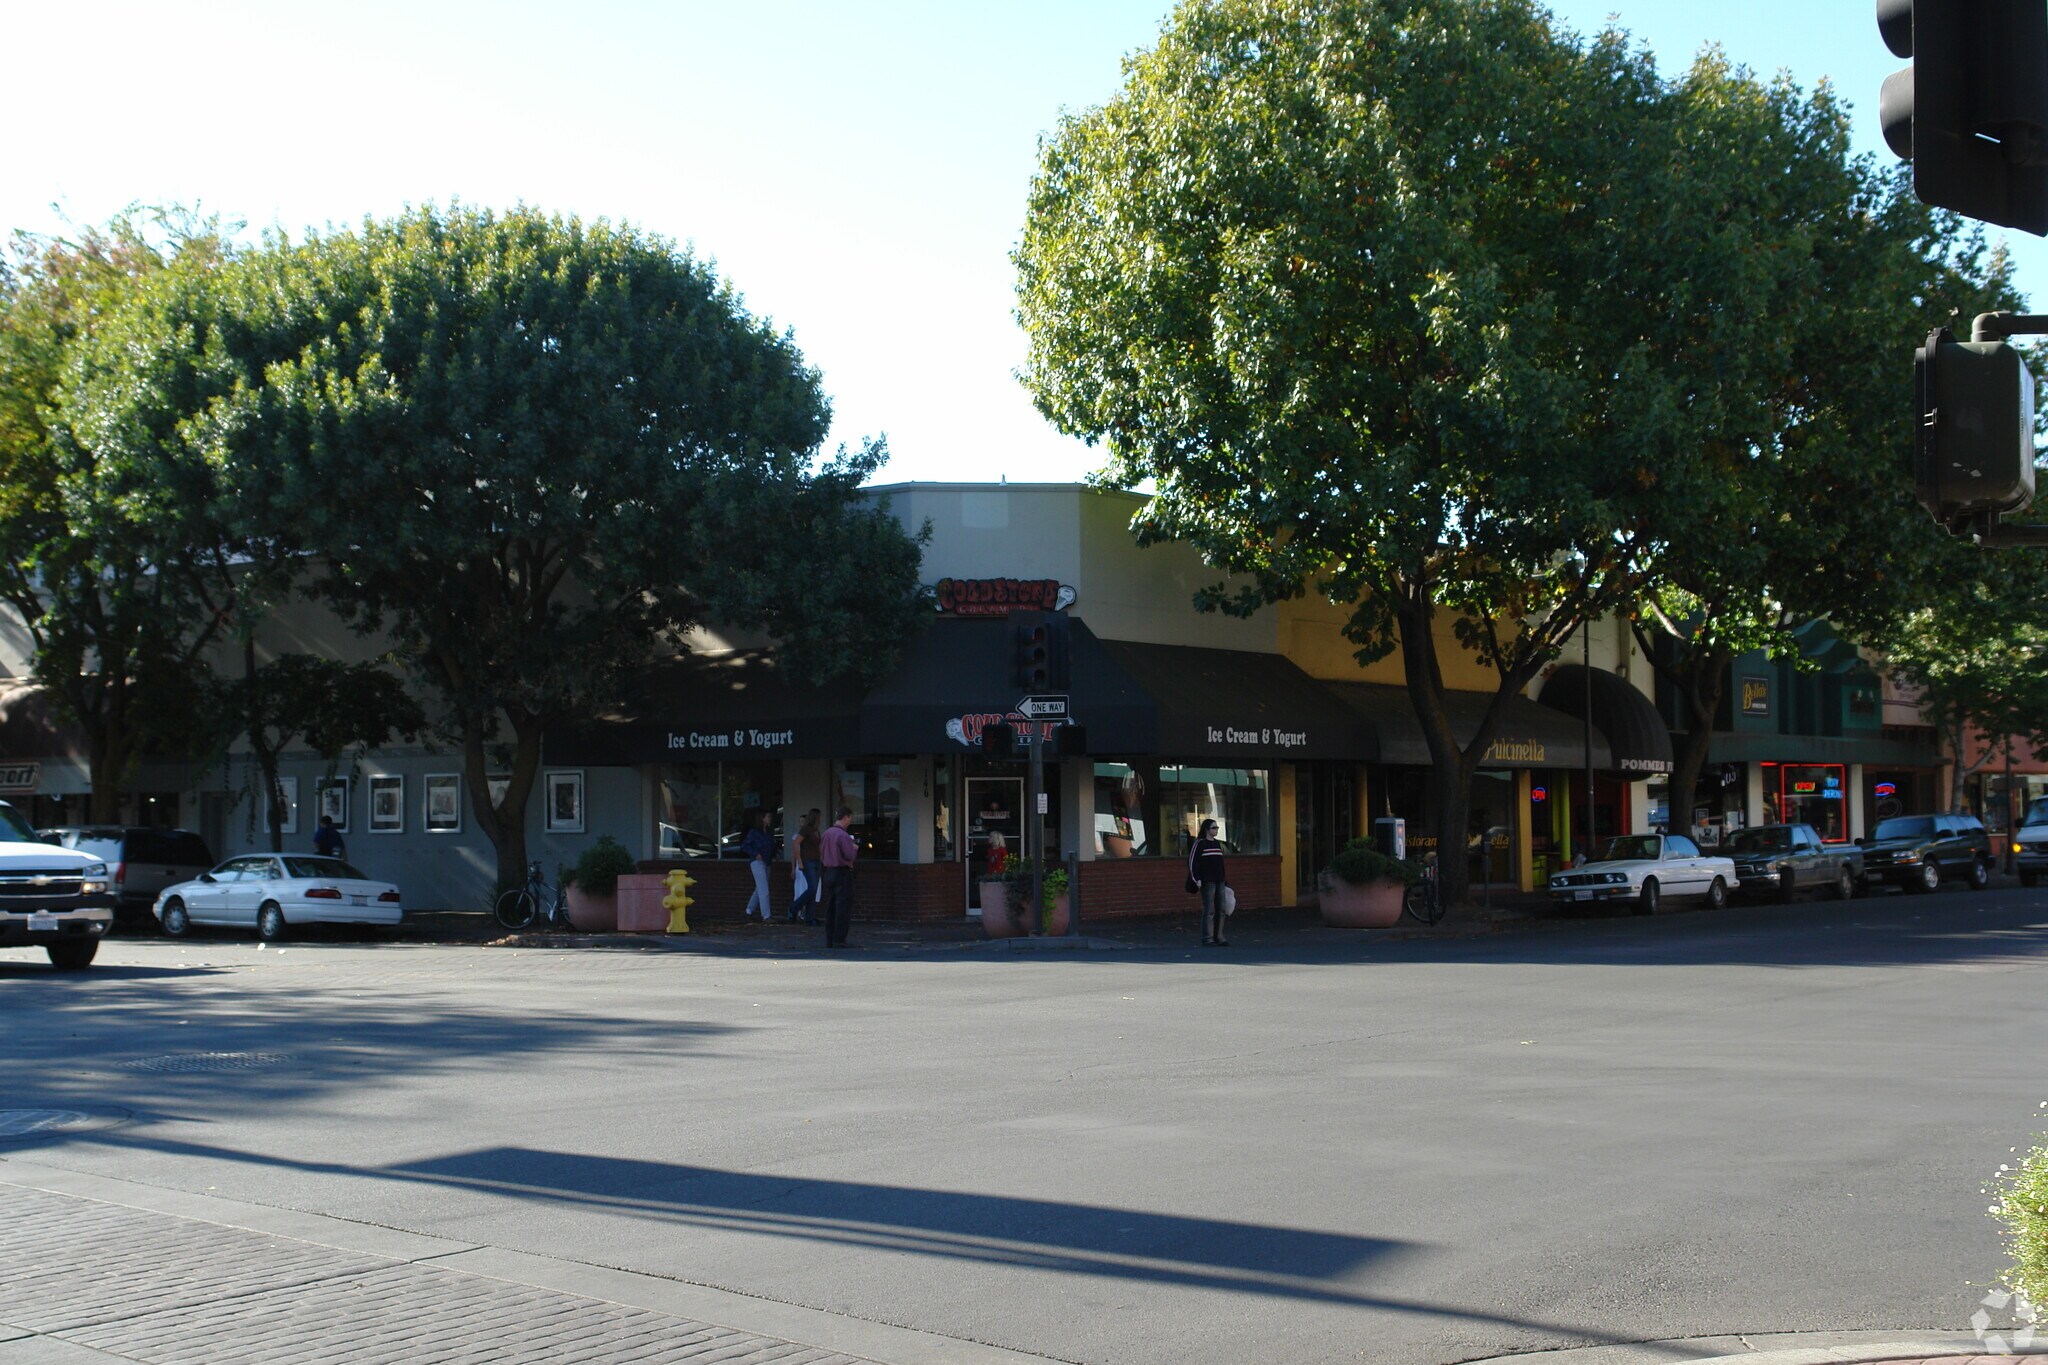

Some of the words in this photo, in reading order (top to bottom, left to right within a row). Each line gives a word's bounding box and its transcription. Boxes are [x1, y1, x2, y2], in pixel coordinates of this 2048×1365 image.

[1031, 703, 1046, 712] ONE
[1048, 703, 1064, 712] WAY
[668, 733, 685, 749] Ice
[690, 732, 729, 748] Cream
[734, 730, 744, 746] &
[749, 729, 793, 749] Yogurt
[1207, 726, 1223, 743] Ice
[1226, 727, 1258, 743] Cream
[1262, 728, 1270, 744] &
[1273, 728, 1306, 748] Yogurt
[1621, 759, 1665, 771] POMMES
